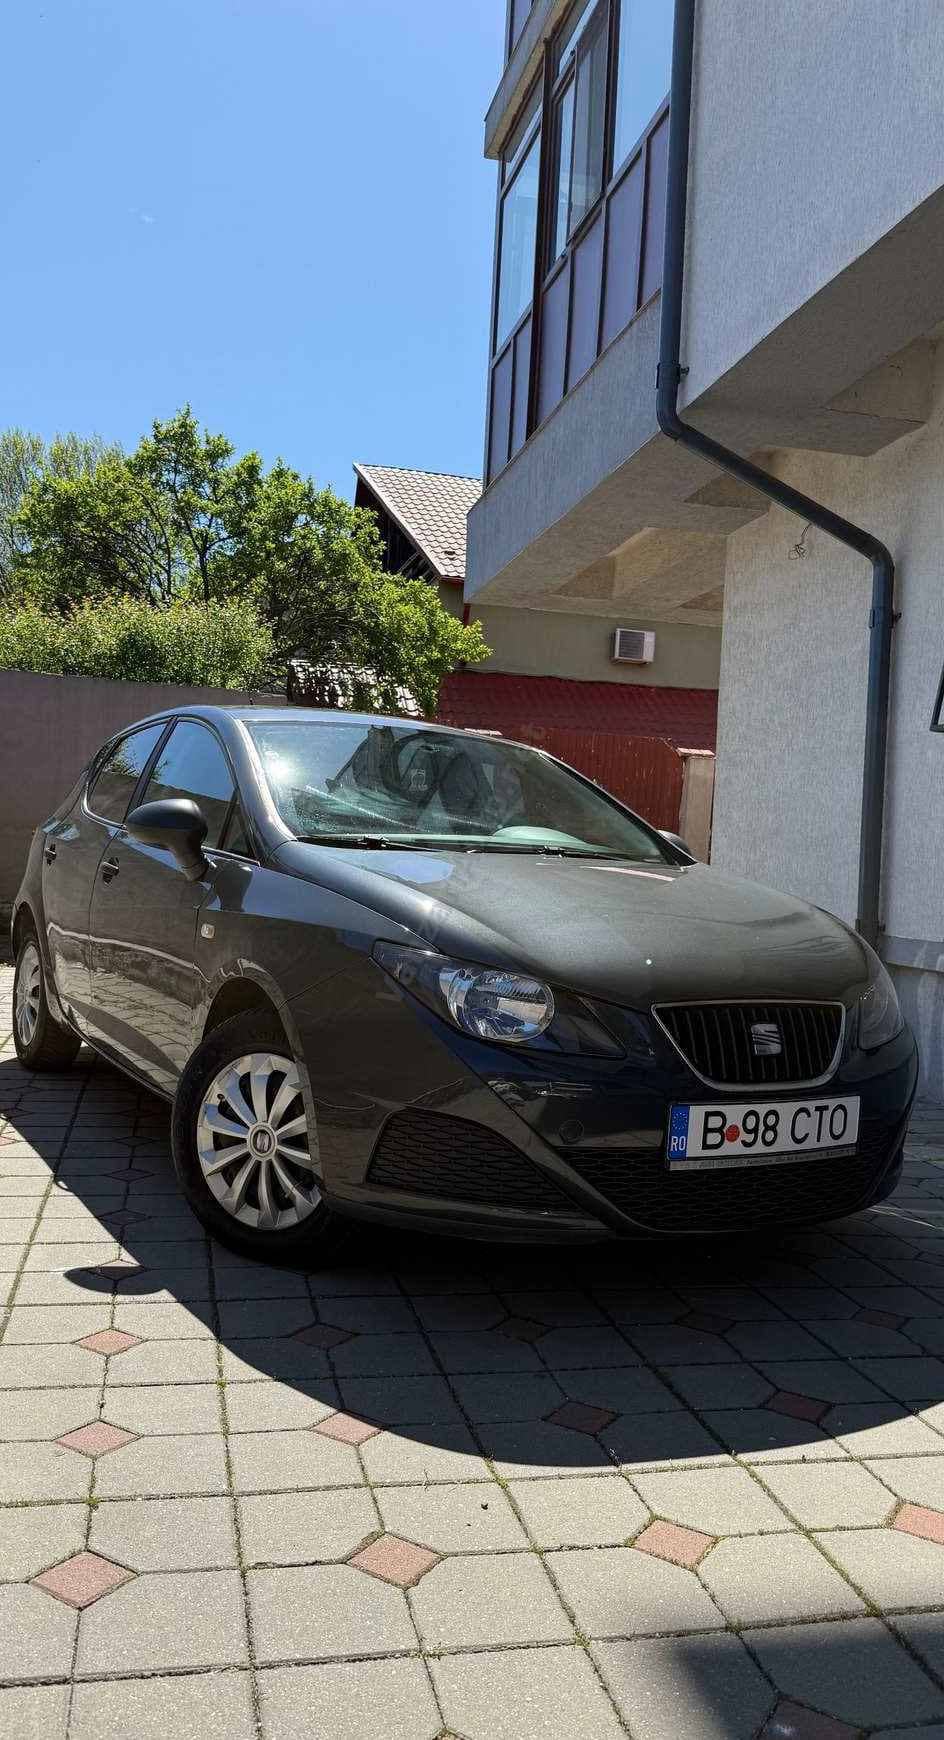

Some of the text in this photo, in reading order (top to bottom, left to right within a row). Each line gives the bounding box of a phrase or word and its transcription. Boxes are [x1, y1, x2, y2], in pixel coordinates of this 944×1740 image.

[670, 1135, 687, 1151] RO
[702, 1103, 848, 1151] B 98 CTO
